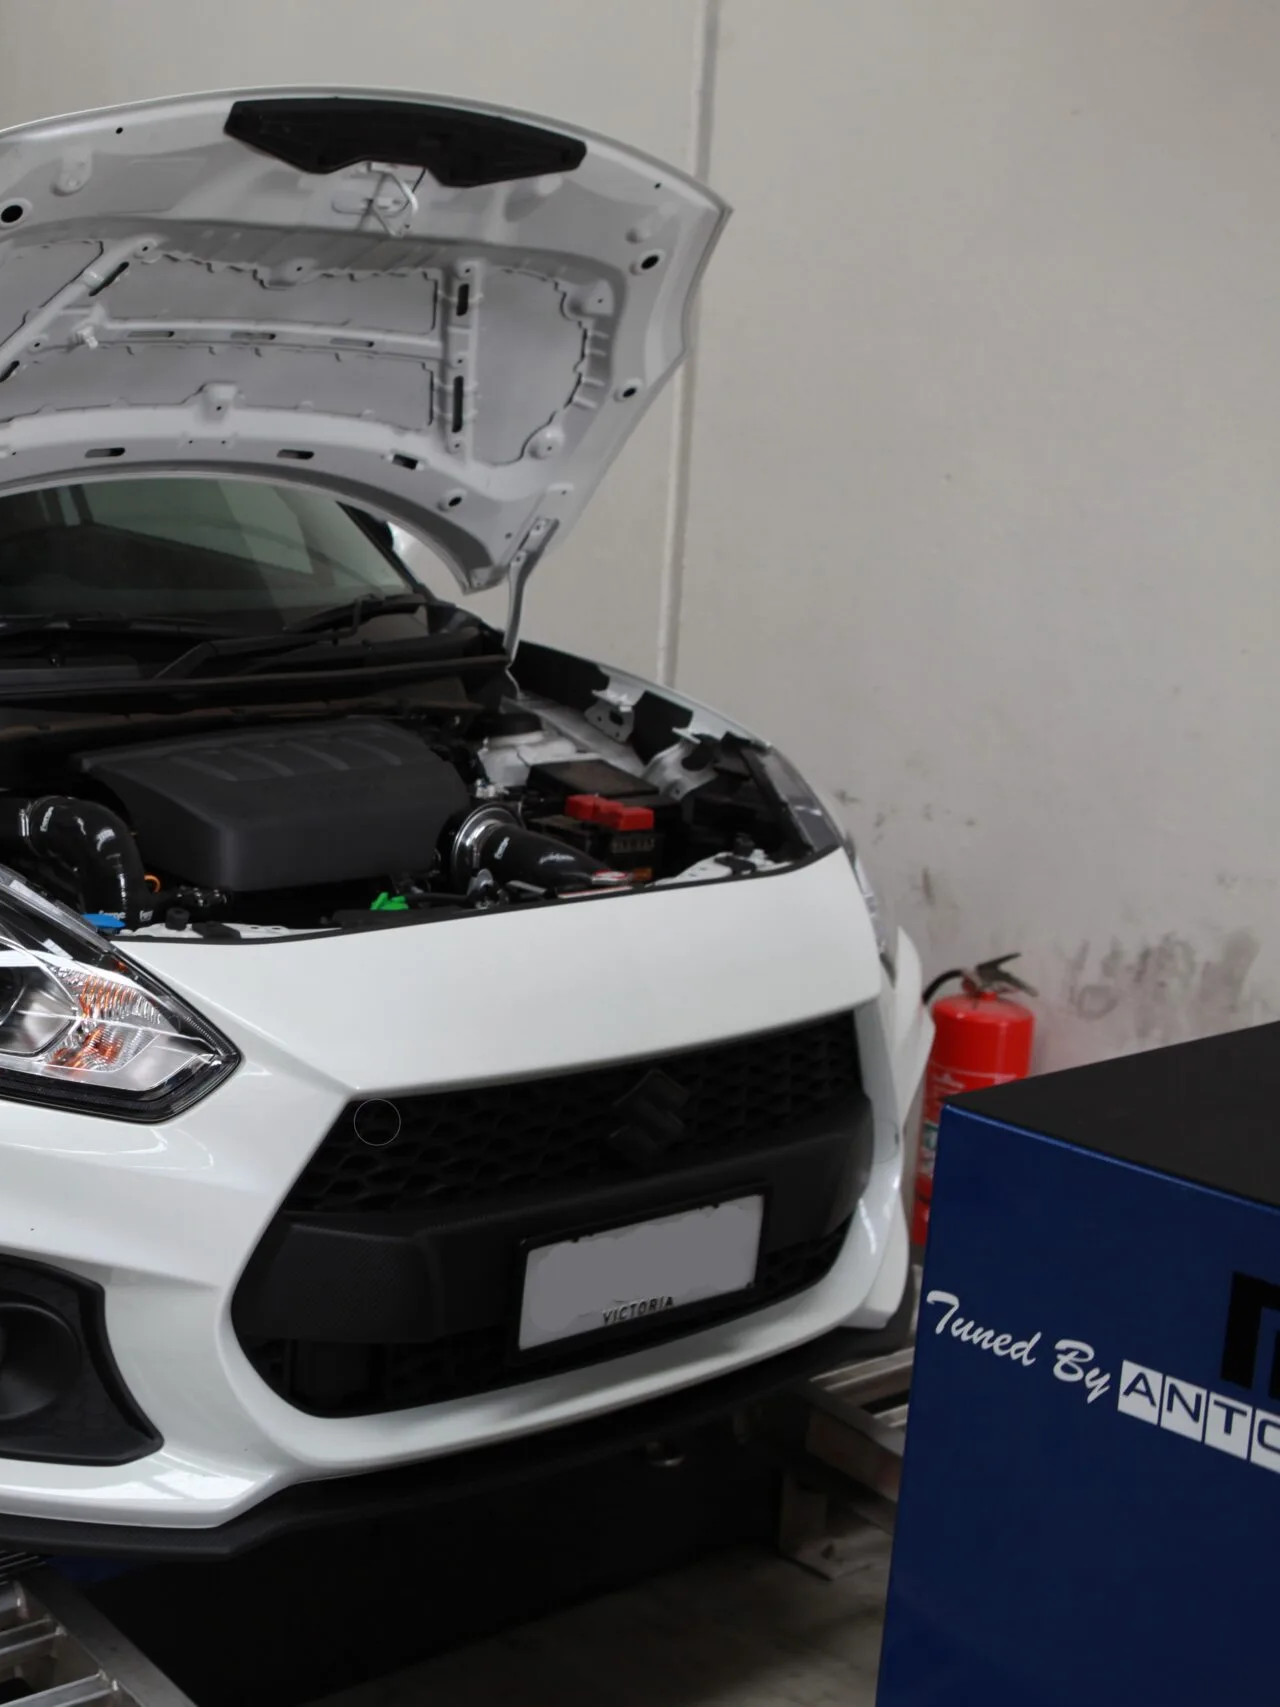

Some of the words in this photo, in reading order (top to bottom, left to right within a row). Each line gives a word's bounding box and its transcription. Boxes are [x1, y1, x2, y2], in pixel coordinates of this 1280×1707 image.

[602, 1296, 673, 1325] VICTORIA
[926, 1289, 1042, 1367] Tuned
[1052, 1339, 1111, 1404] By
